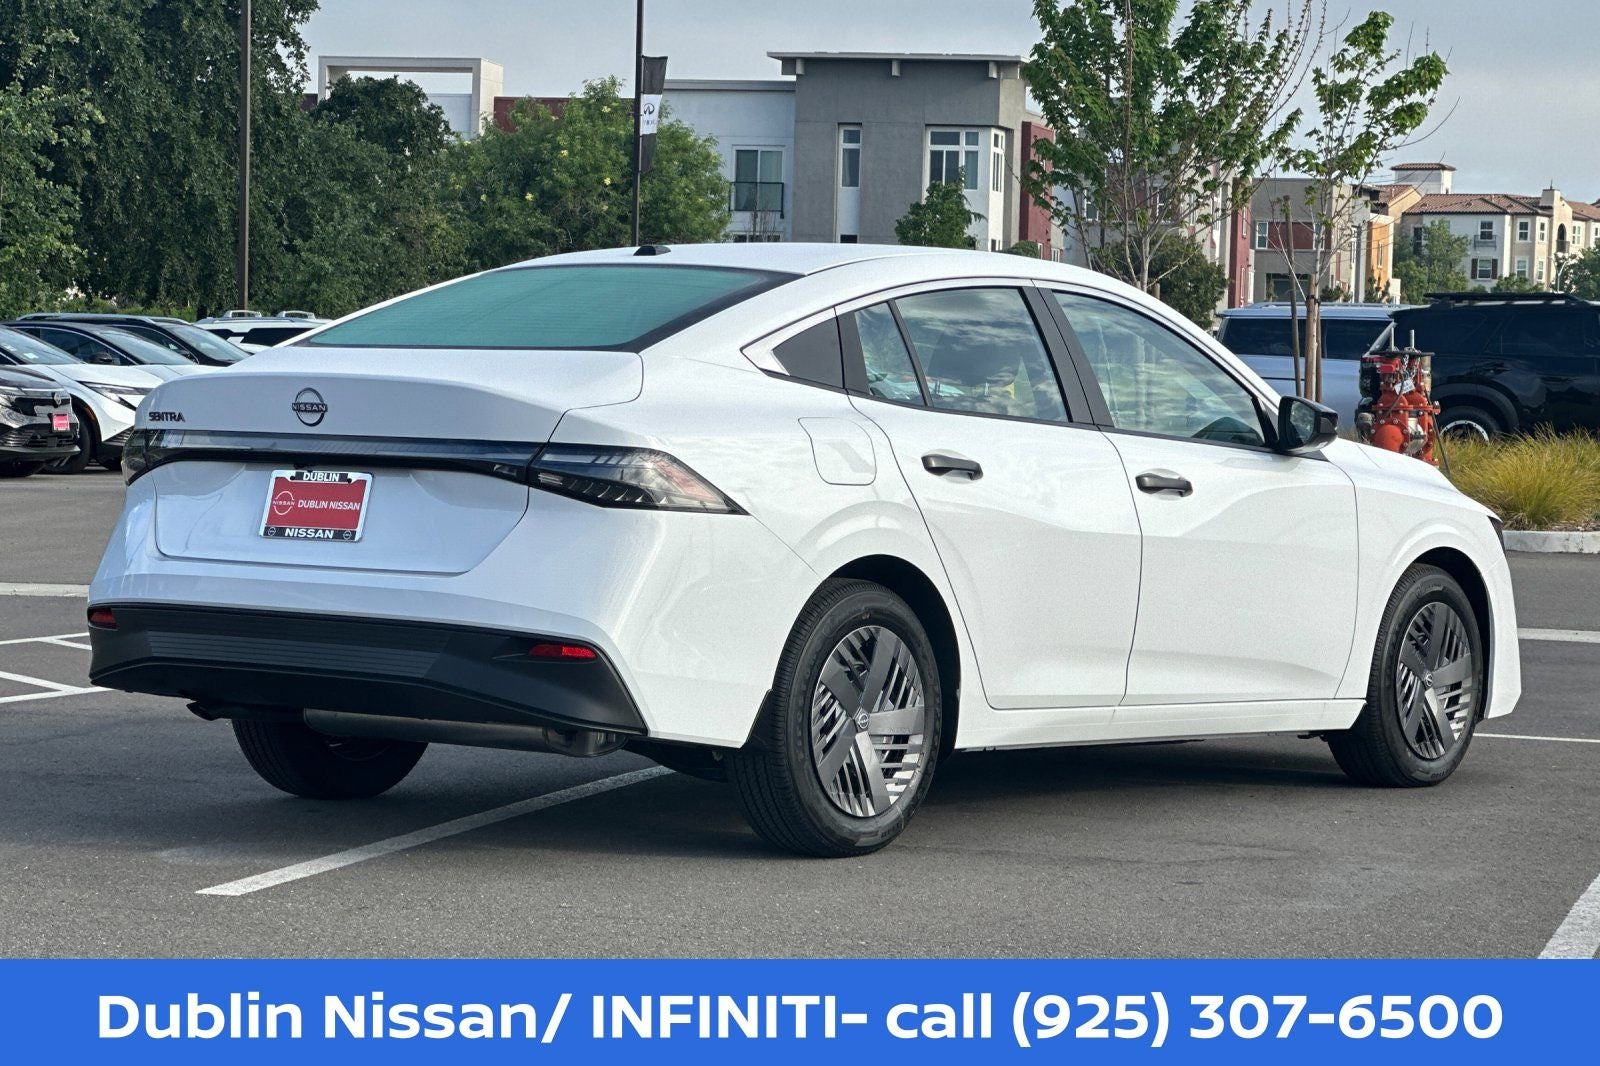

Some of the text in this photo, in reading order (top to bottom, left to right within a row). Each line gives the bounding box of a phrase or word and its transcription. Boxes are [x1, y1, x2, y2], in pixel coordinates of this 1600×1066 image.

[293, 403, 326, 412] NISSAN
[148, 411, 185, 423] SENTRA
[302, 472, 340, 482] DUBLIN
[297, 499, 361, 511] DUBLIN NISSAN
[284, 527, 334, 539] NISSAN
